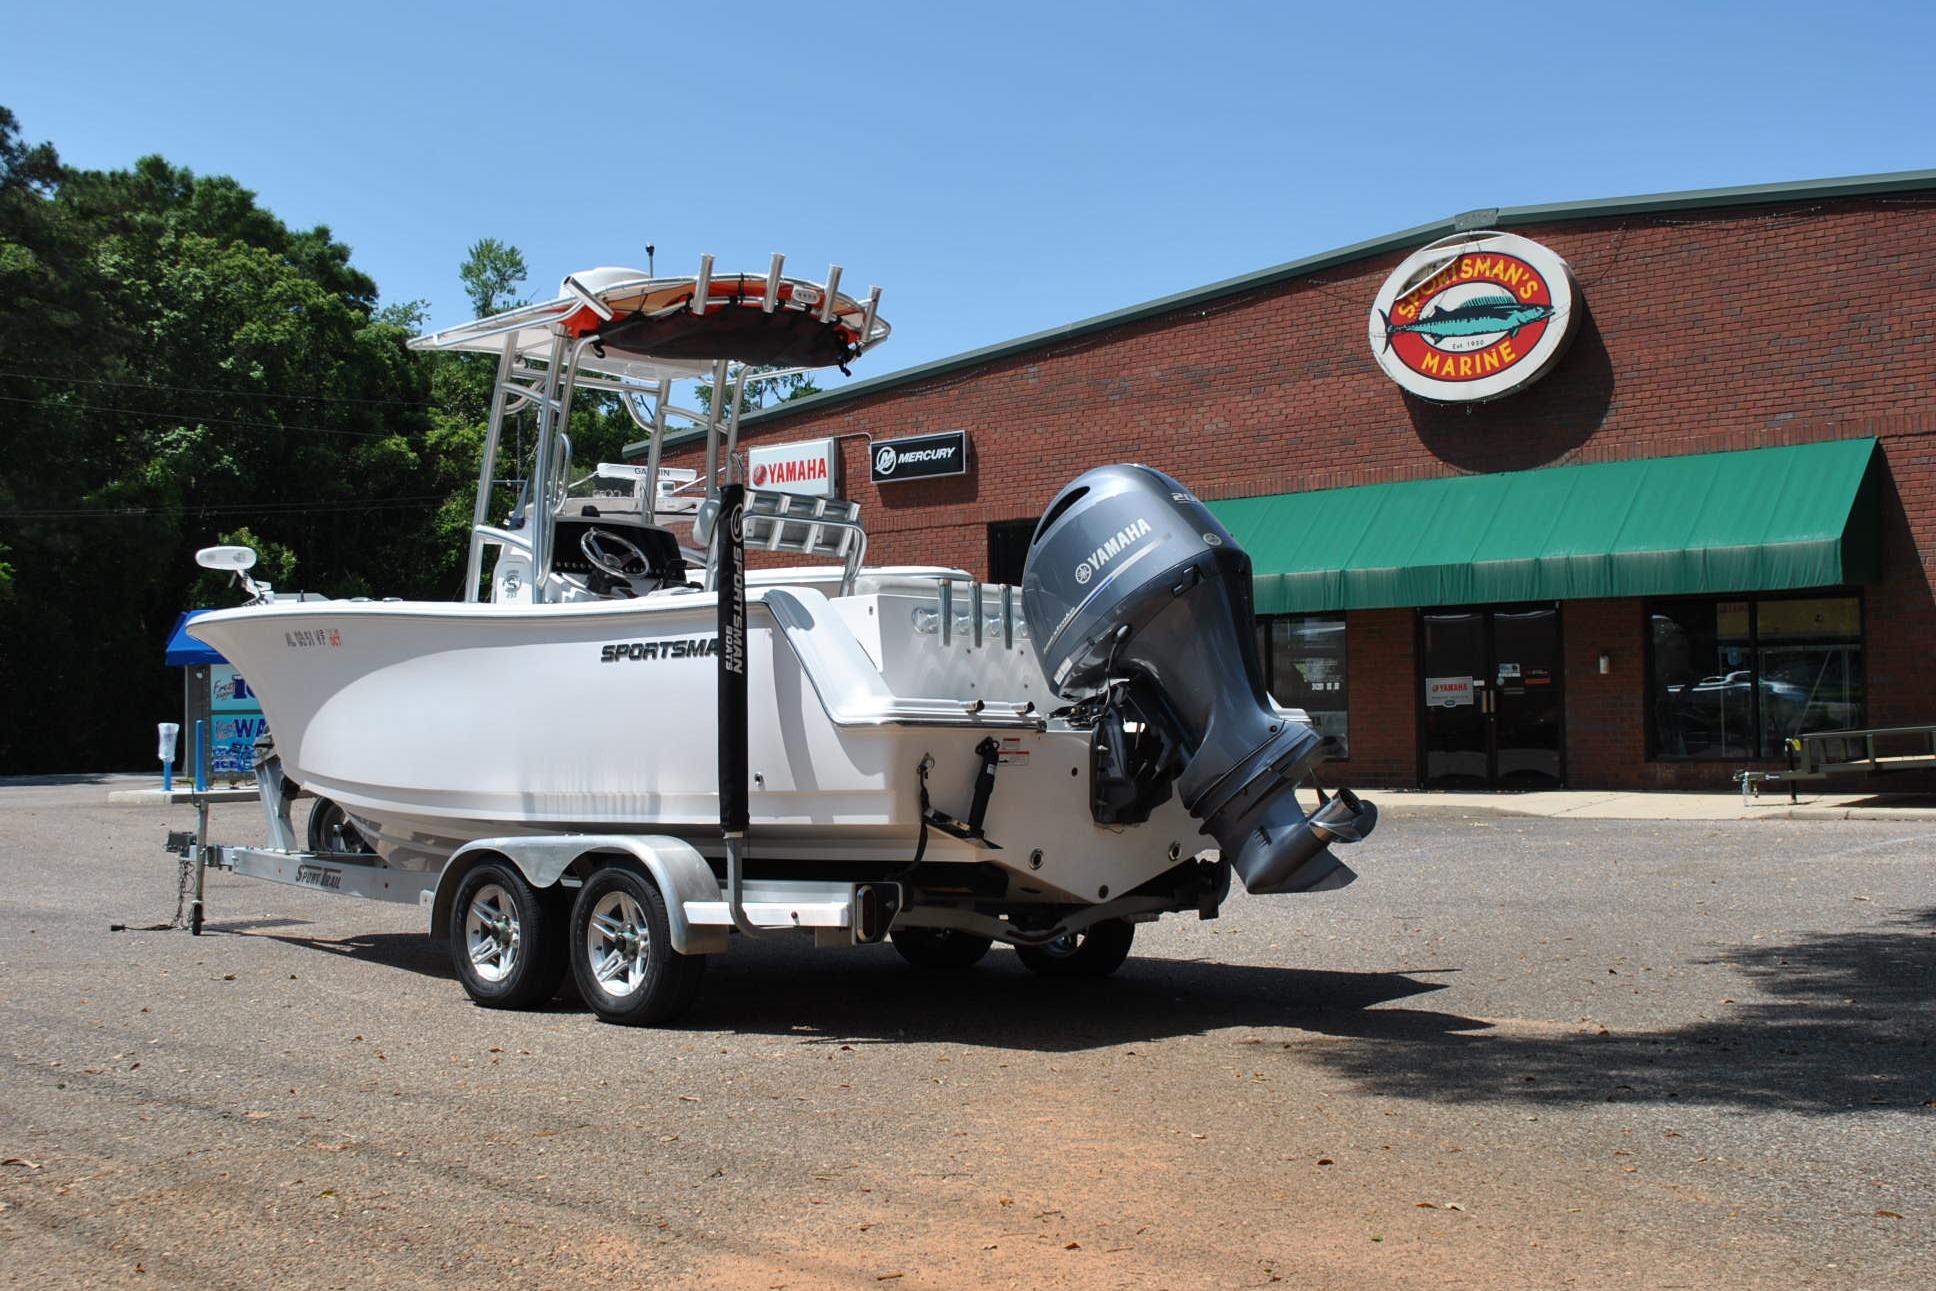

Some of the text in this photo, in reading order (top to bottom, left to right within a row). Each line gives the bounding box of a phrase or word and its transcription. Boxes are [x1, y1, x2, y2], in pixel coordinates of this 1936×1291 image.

[1421, 341, 1516, 376] MARINE
[898, 446, 956, 464] MERCURY
[634, 467, 670, 477] GAIN
[768, 457, 827, 484] YAMAHA
[1088, 518, 1152, 570] YAMAHA
[733, 547, 743, 674] SPORTSMAN
[601, 638, 719, 663] SPORTSMA
[725, 625, 733, 671] BOATS
[1440, 683, 1468, 693] YAMAHA
